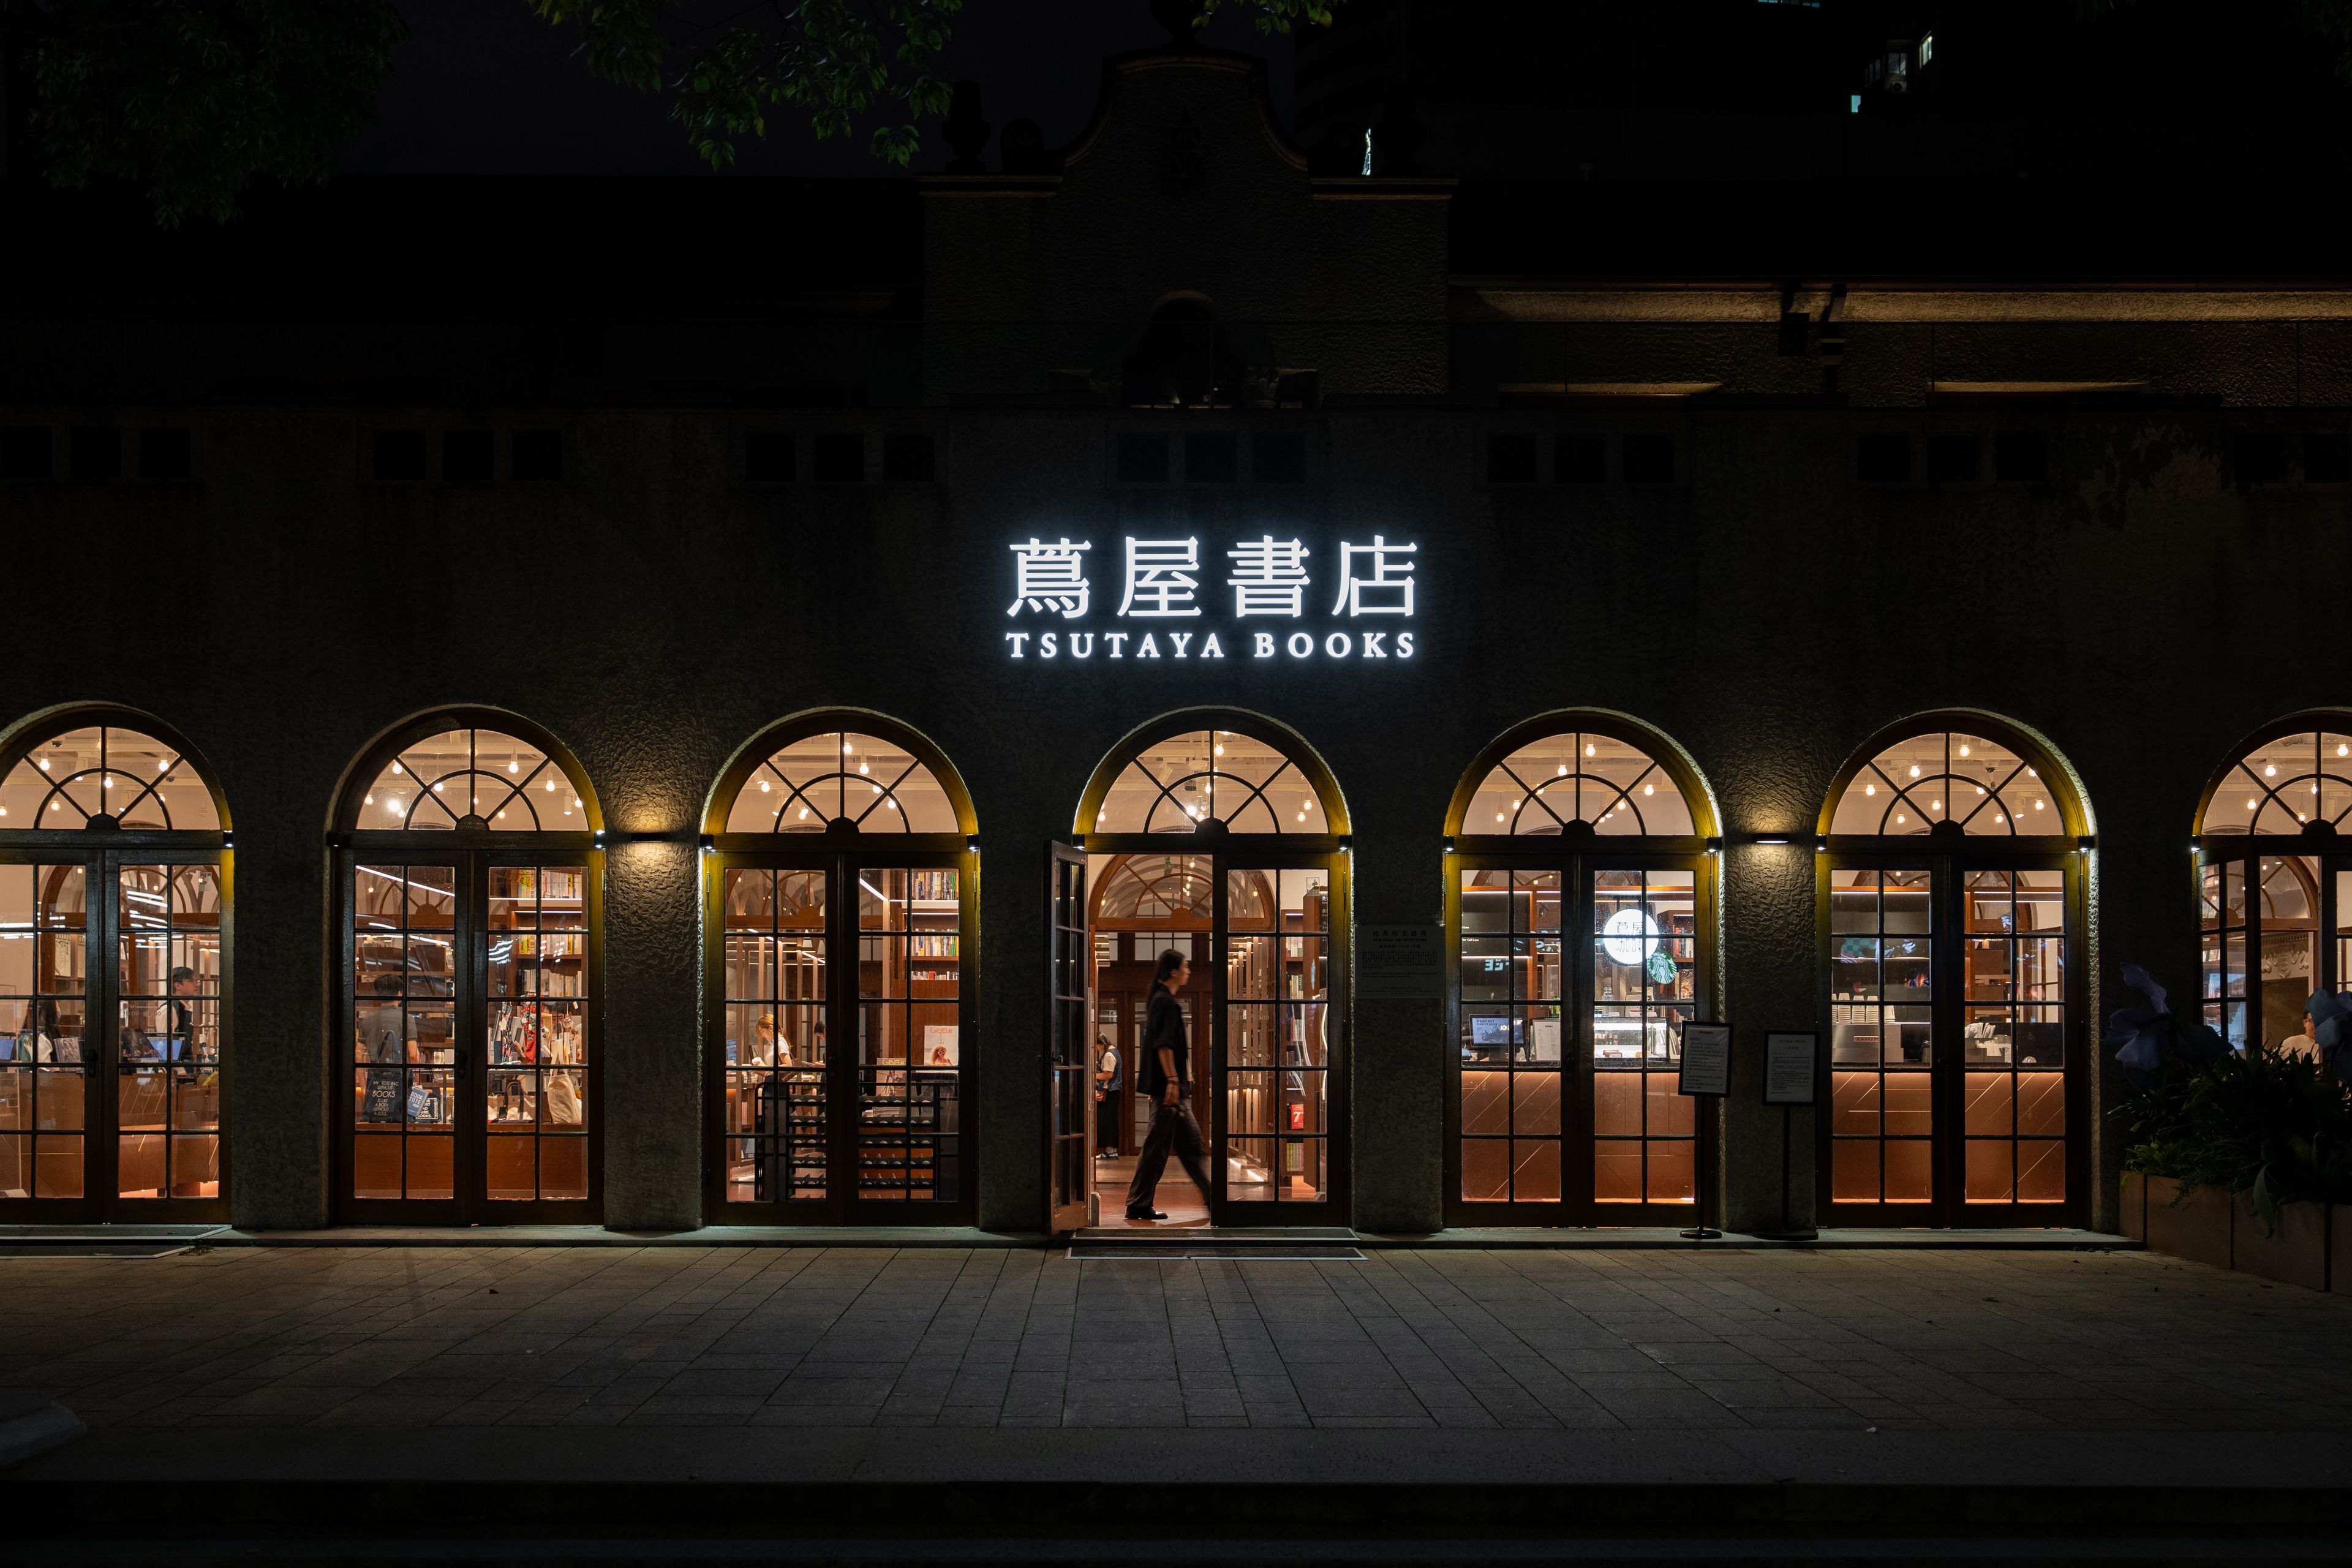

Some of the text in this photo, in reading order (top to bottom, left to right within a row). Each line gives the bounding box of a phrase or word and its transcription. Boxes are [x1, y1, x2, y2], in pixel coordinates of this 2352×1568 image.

[1006, 535, 1417, 619] 蔦屋書店
[1005, 631, 1414, 658] TSUTAYA BOOKS
[409, 1096, 421, 1105] TOTE
[410, 1091, 423, 1100] BOOK
